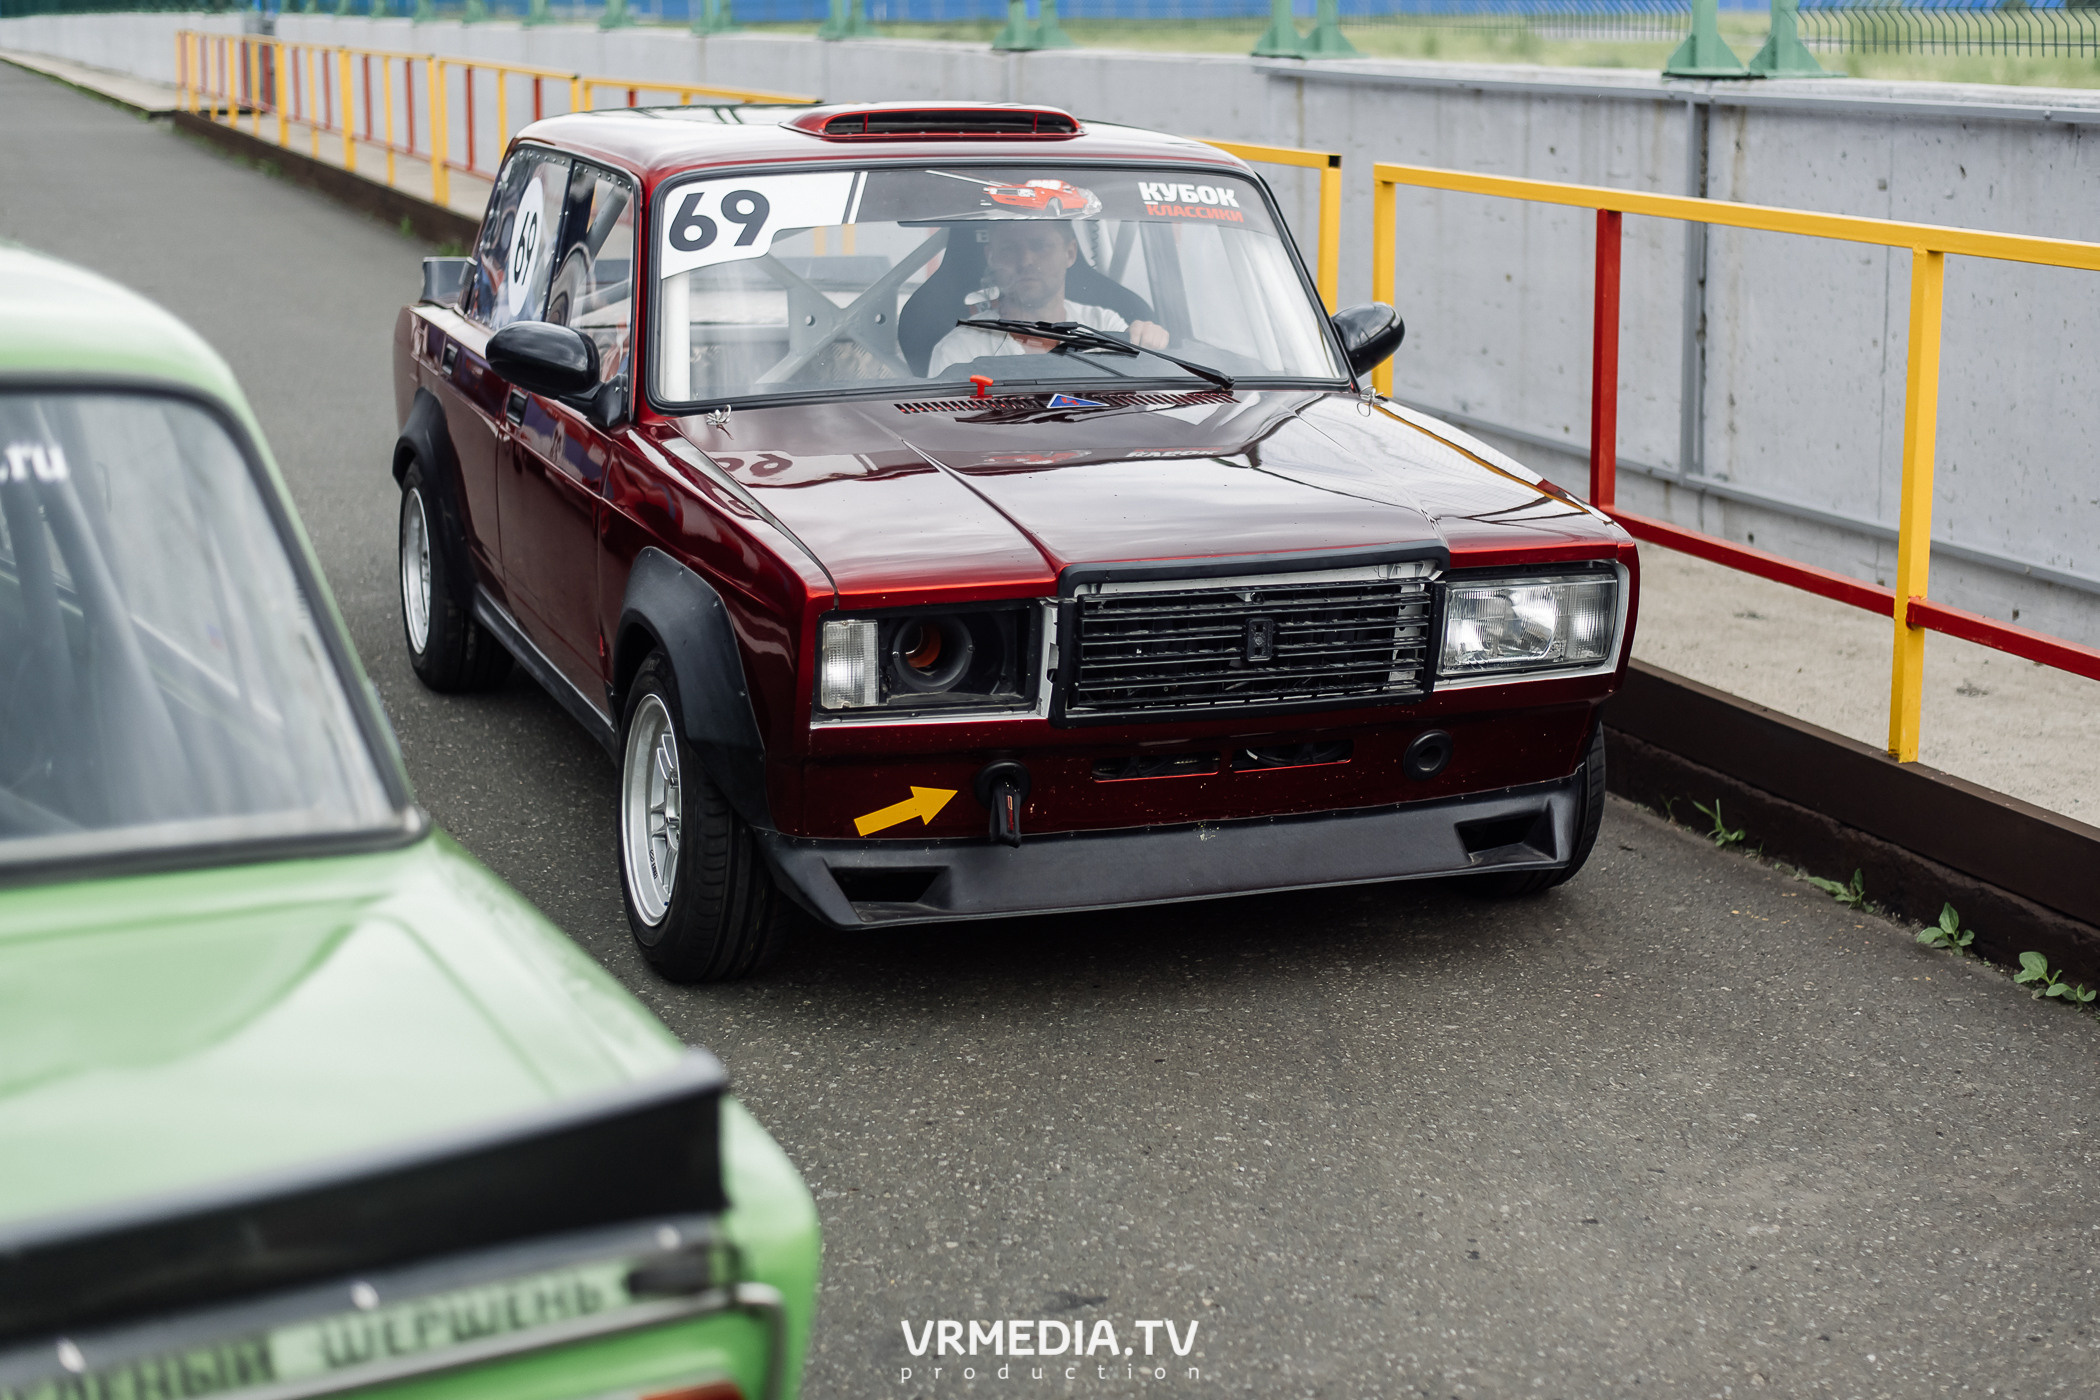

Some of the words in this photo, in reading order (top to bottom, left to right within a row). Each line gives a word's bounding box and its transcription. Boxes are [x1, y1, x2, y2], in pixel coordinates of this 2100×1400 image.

[1138, 182, 1240, 208] КУБОК
[1146, 204, 1244, 223] КЛАССИКИ
[669, 189, 770, 252] 69
[514, 211, 538, 286] 69
